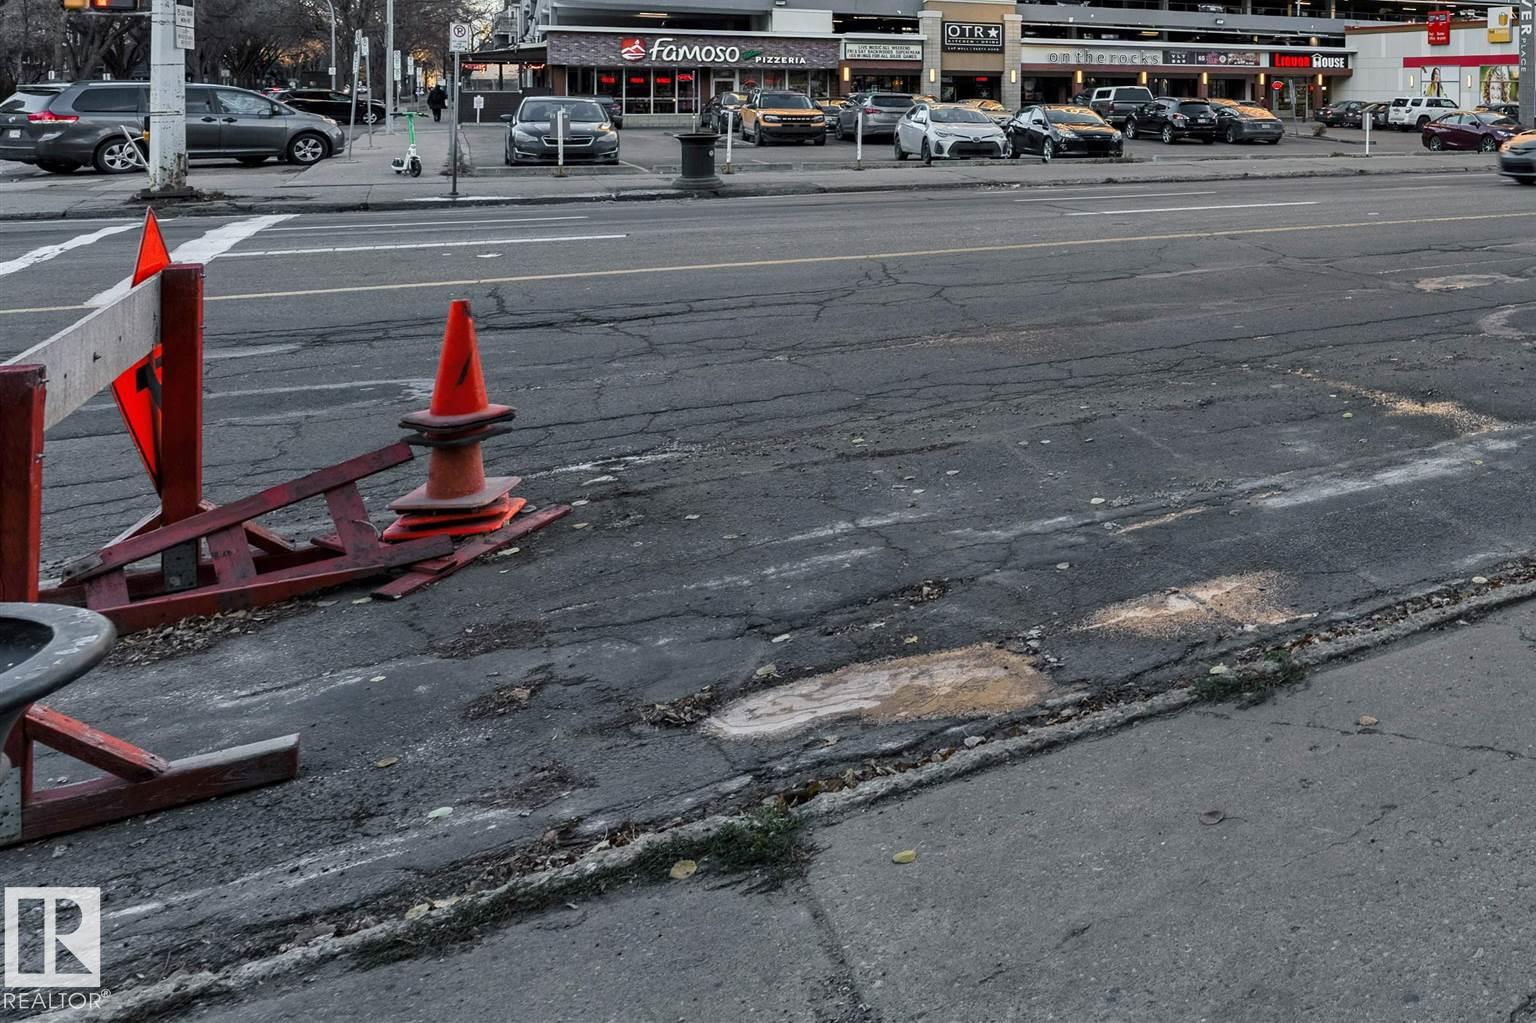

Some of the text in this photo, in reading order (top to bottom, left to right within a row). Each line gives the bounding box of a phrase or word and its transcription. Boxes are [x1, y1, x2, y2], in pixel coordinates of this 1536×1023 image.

[948, 25, 984, 38] OTR
[755, 57, 807, 65] PIZZERIA
[1049, 48, 1159, 64] on the rocks
[1275, 53, 1345, 68] LIQUOR HOUSE
